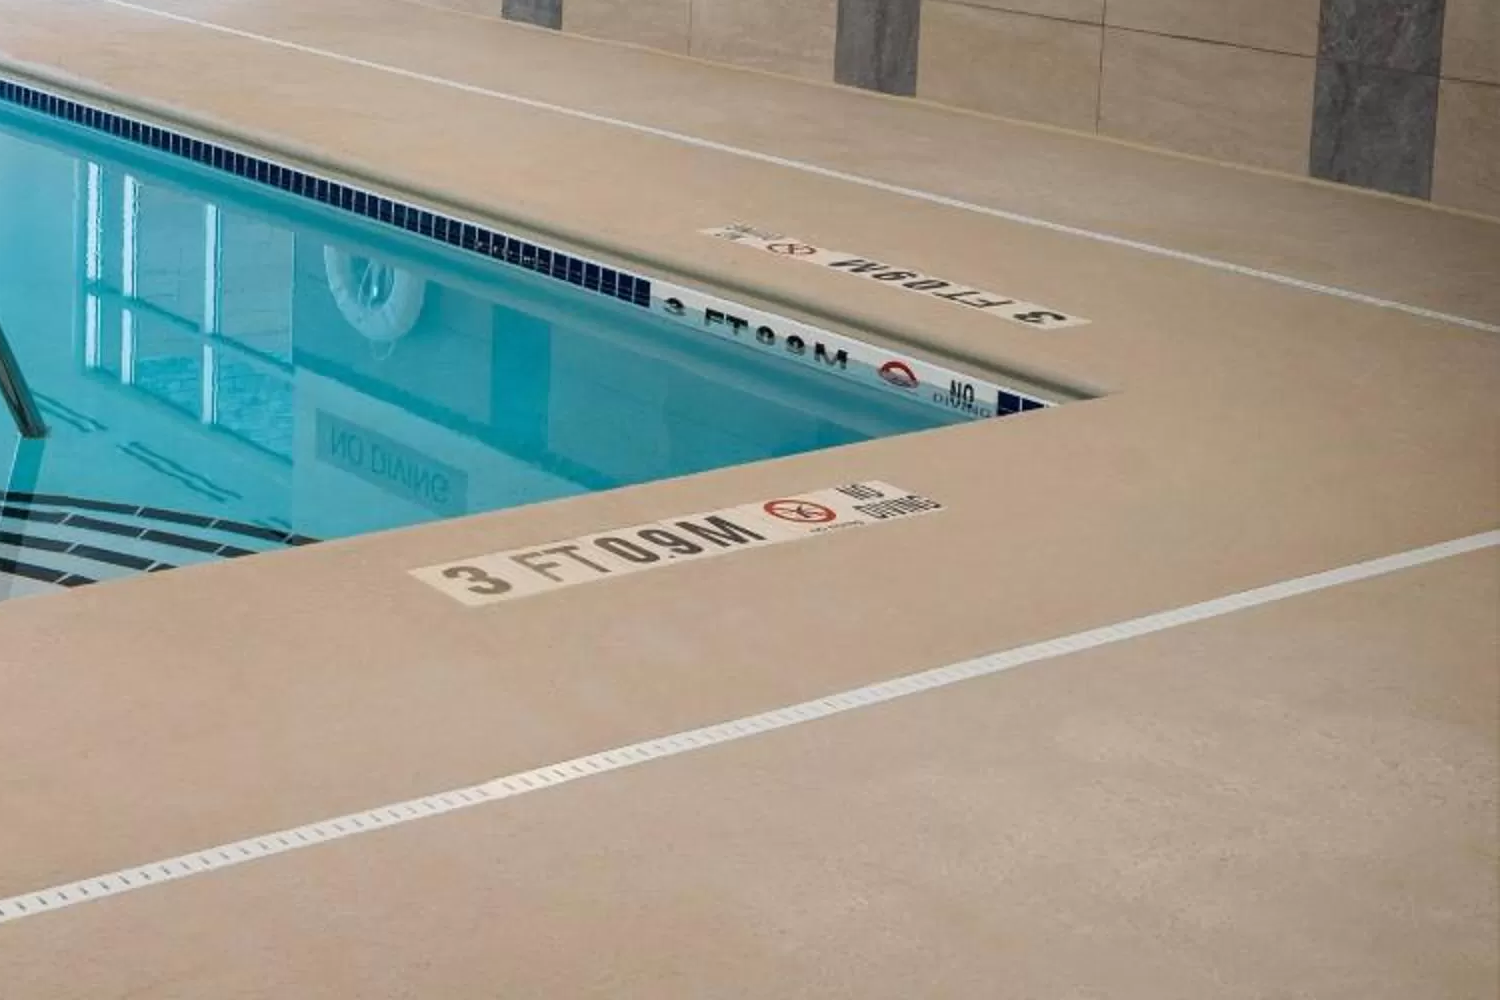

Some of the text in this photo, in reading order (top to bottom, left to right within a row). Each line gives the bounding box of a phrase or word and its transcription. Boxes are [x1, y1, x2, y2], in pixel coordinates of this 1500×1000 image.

[1012, 310, 1067, 324] 3
[835, 483, 885, 501] NO
[851, 495, 942, 520] DIVING
[442, 565, 513, 595] 3
[509, 545, 612, 583] FT
